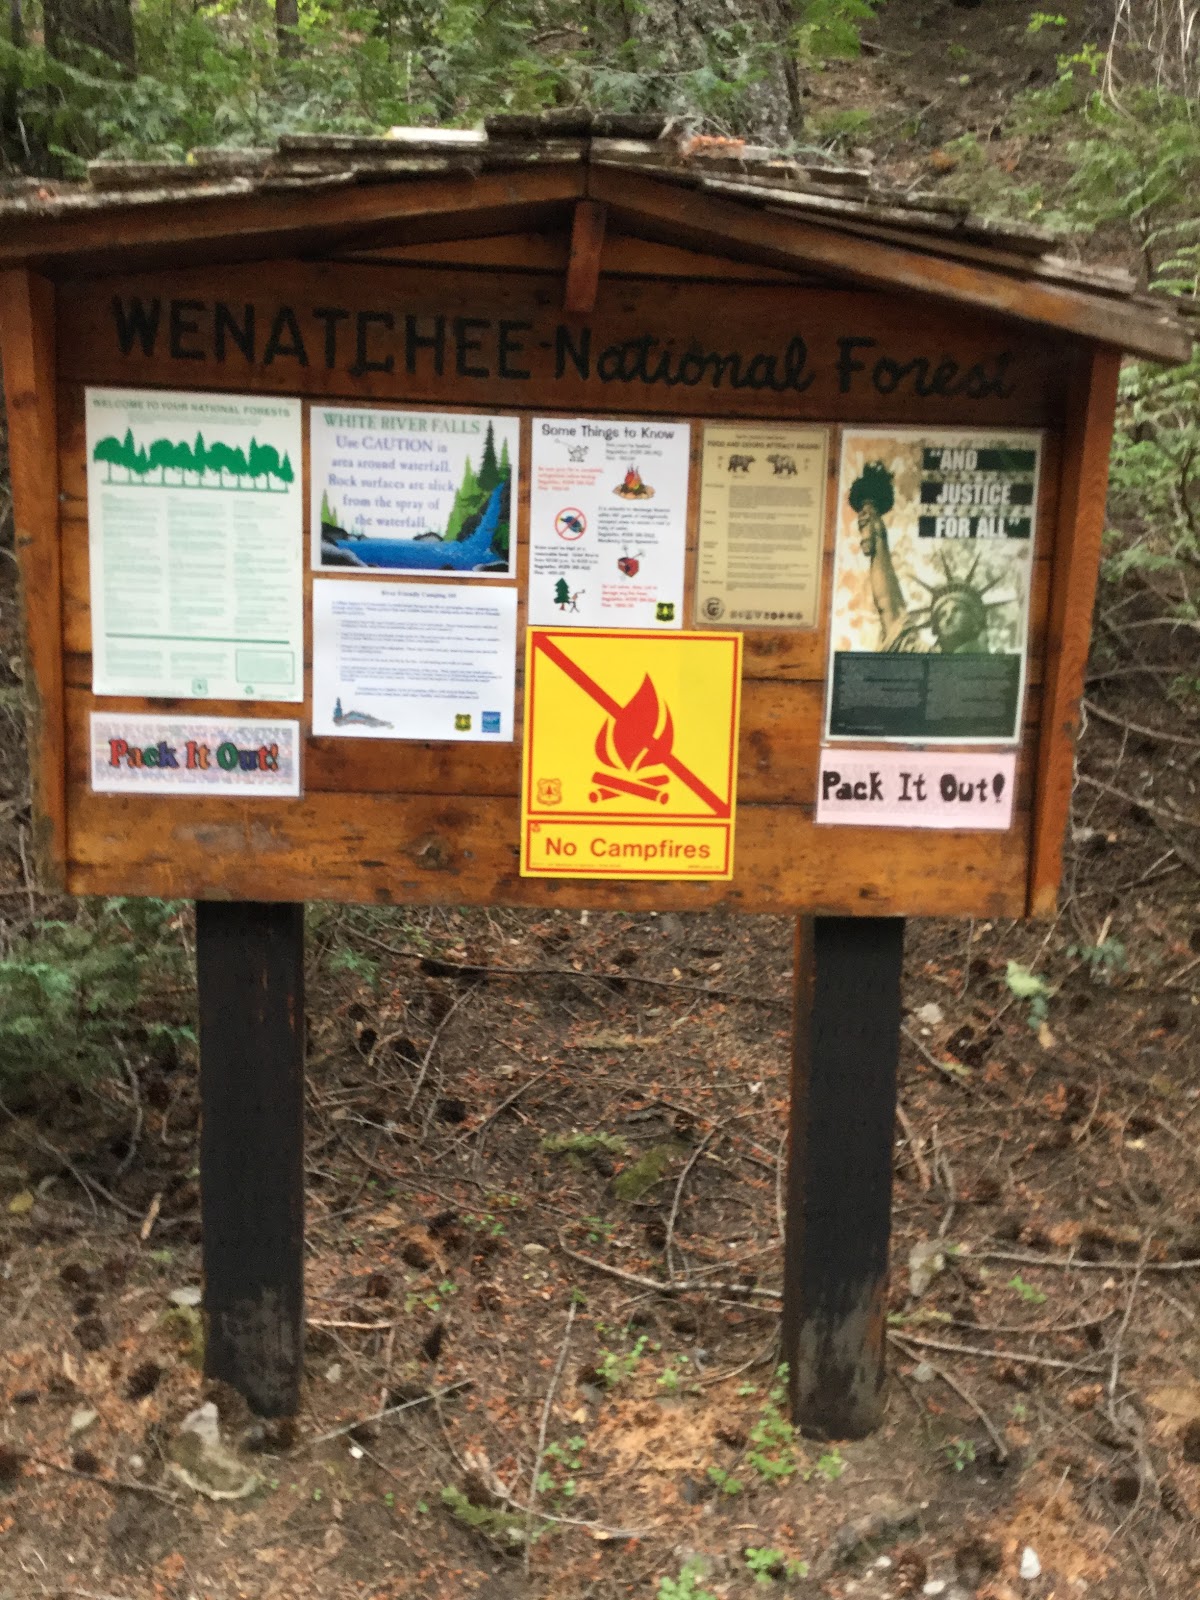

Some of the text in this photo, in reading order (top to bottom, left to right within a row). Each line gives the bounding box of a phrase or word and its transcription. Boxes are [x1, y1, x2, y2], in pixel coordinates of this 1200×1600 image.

[112, 297, 1015, 400] WENATCHEE National Forest
[324, 413, 481, 434] WHITE RIVER FALLS
[542, 423, 676, 441] Some Things to Know
[335, 435, 448, 453] Use CAUTION in
[332, 459, 353, 468] area
[357, 457, 396, 470] around
[328, 472, 454, 492] Rock surfaces are slick
[936, 480, 1012, 505] JUSTICE
[342, 494, 439, 513] from the spray of
[355, 514, 372, 526] the
[935, 516, 971, 538] FOR
[109, 738, 280, 773] Pack It Out!
[822, 770, 1006, 803] Pack It Out!
[545, 837, 711, 862] No Campfires
